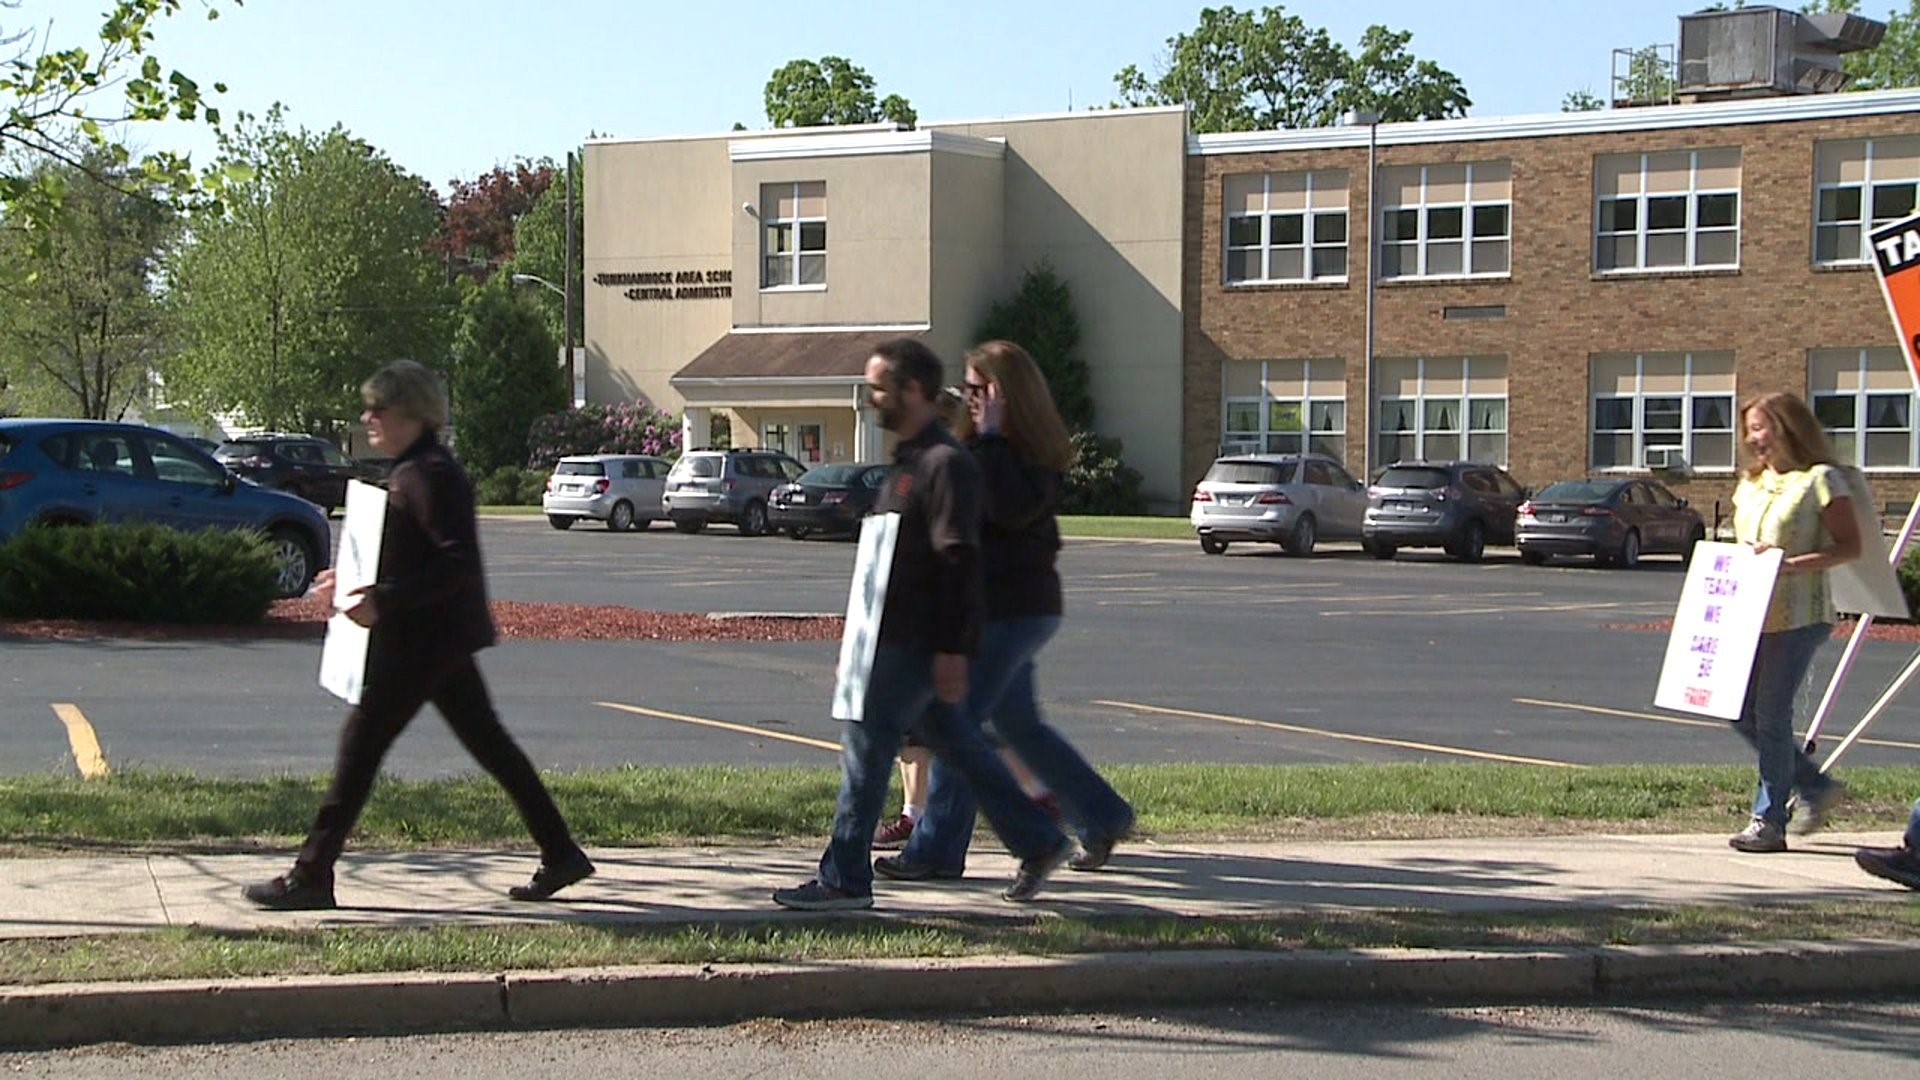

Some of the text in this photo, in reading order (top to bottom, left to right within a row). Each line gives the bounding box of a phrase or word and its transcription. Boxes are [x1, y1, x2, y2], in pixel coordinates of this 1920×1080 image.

[675, 271, 704, 284] AREA
[628, 288, 673, 300] CENTRAL
[1704, 577, 1738, 596] TEACH
